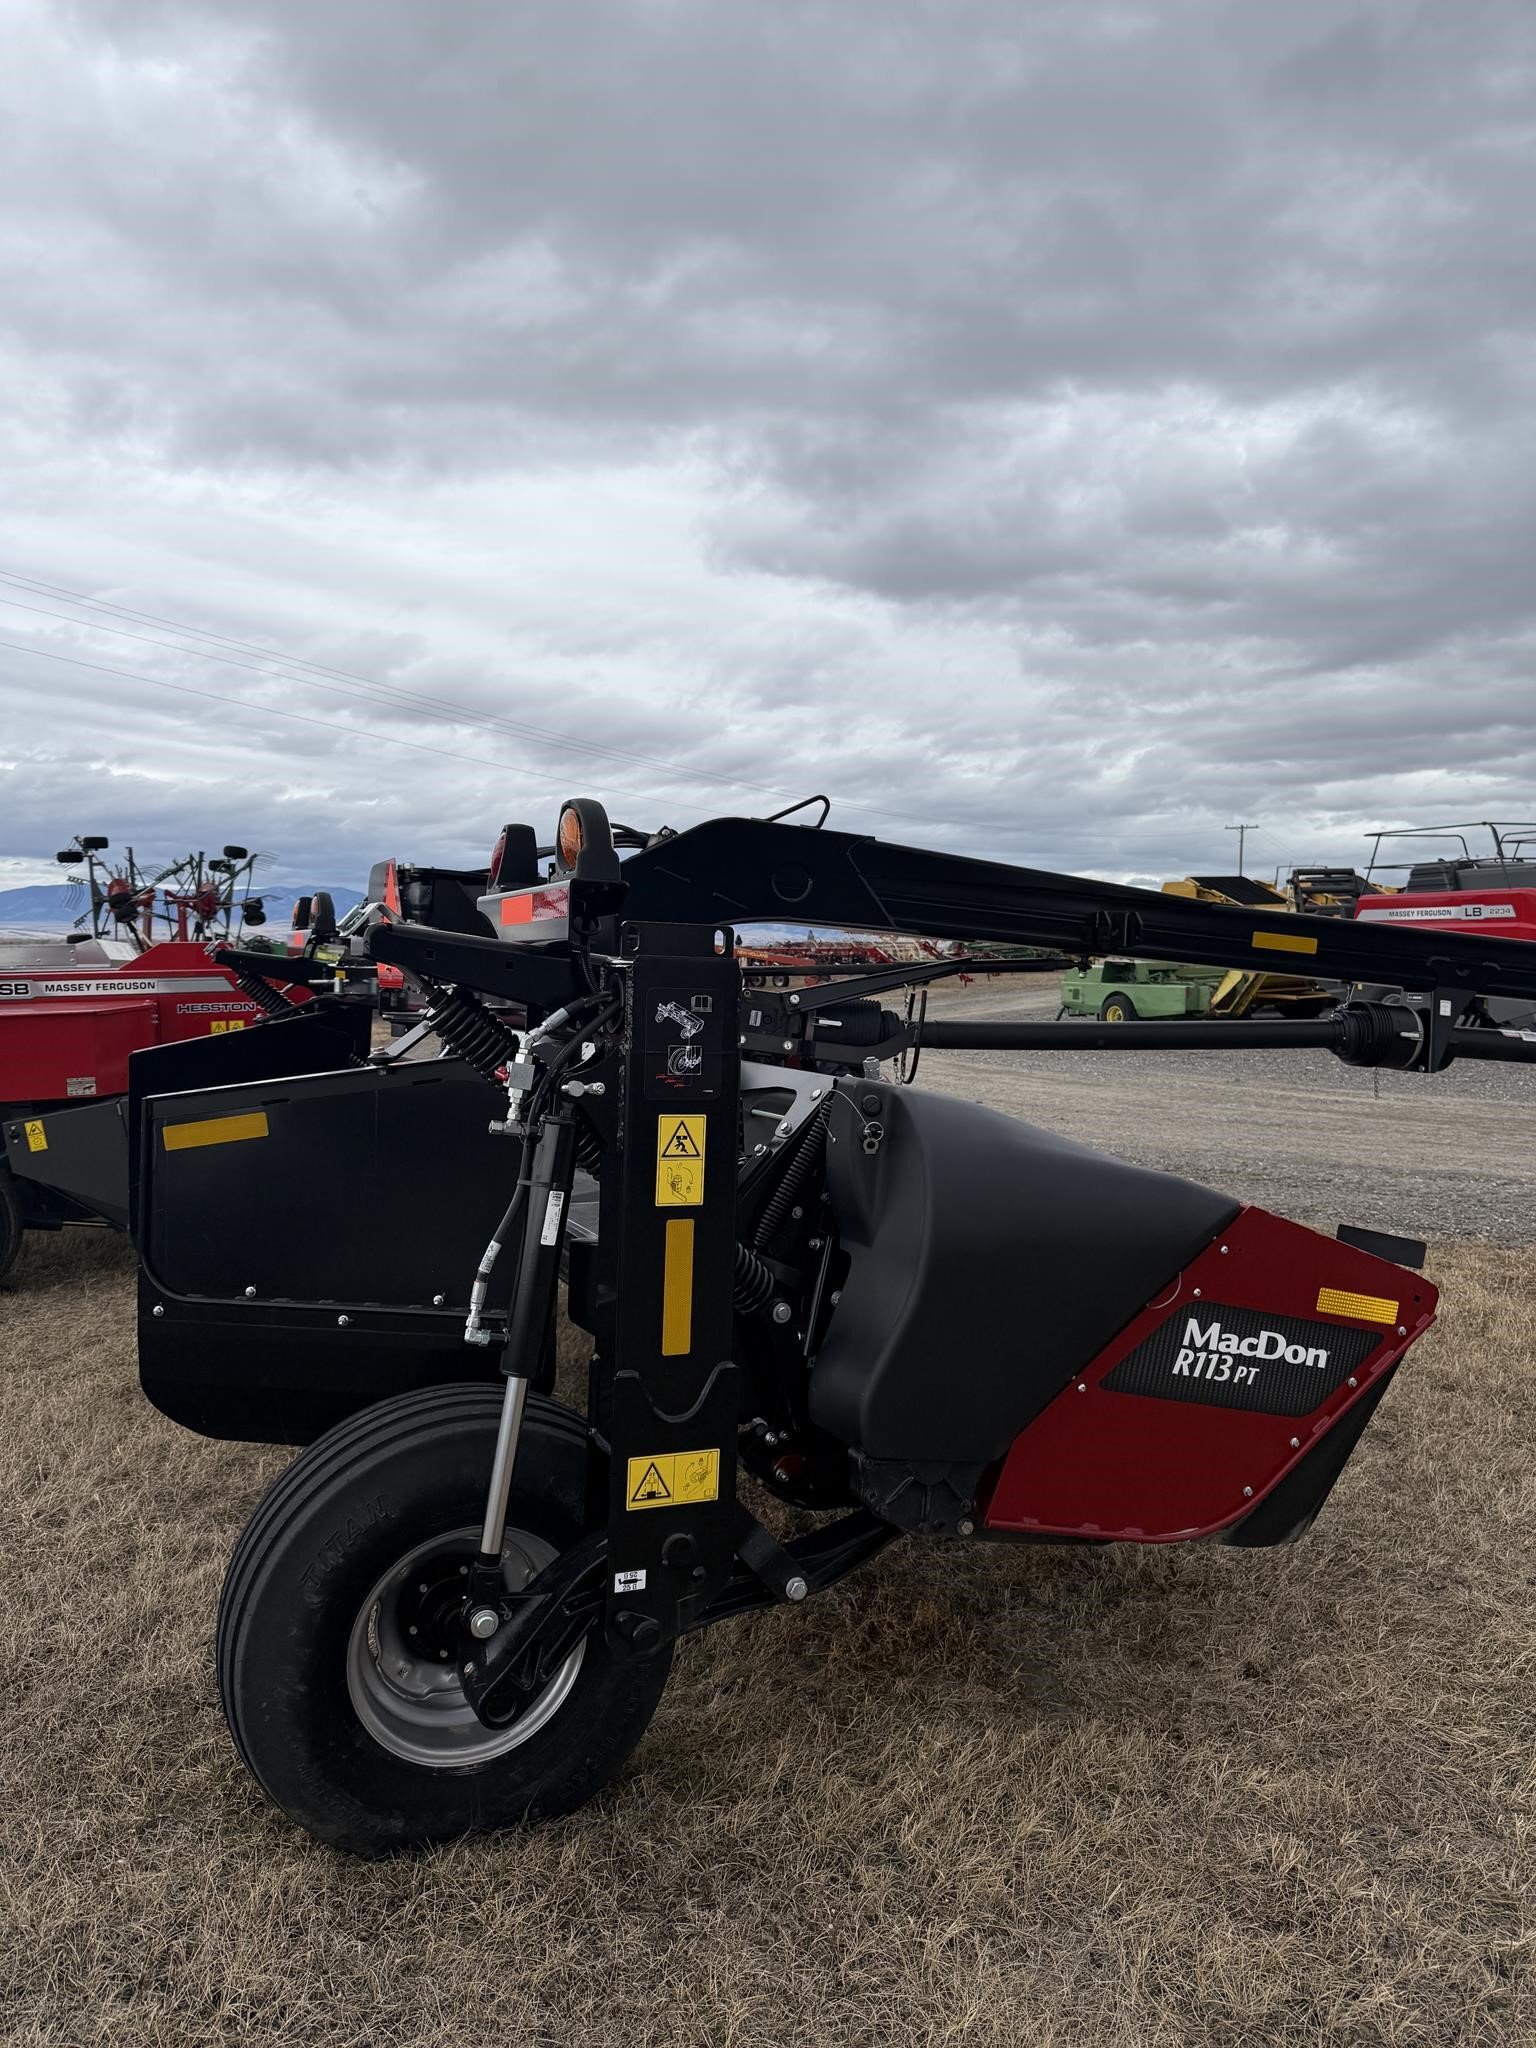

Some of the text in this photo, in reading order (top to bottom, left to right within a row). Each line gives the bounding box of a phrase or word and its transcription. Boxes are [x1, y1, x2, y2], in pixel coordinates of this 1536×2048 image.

[1388, 910, 1415, 918] MASSEY
[1416, 908, 1452, 917] FERGUSON
[1464, 907, 1482, 917] LB
[44, 983, 92, 993] MASSEY
[95, 981, 156, 991] FERGUSON
[176, 1002, 257, 1014] HESSTON
[1182, 1318, 1330, 1369] MacDon
[1172, 1348, 1260, 1385] R113 PT
[300, 1495, 387, 1589] TITAN
